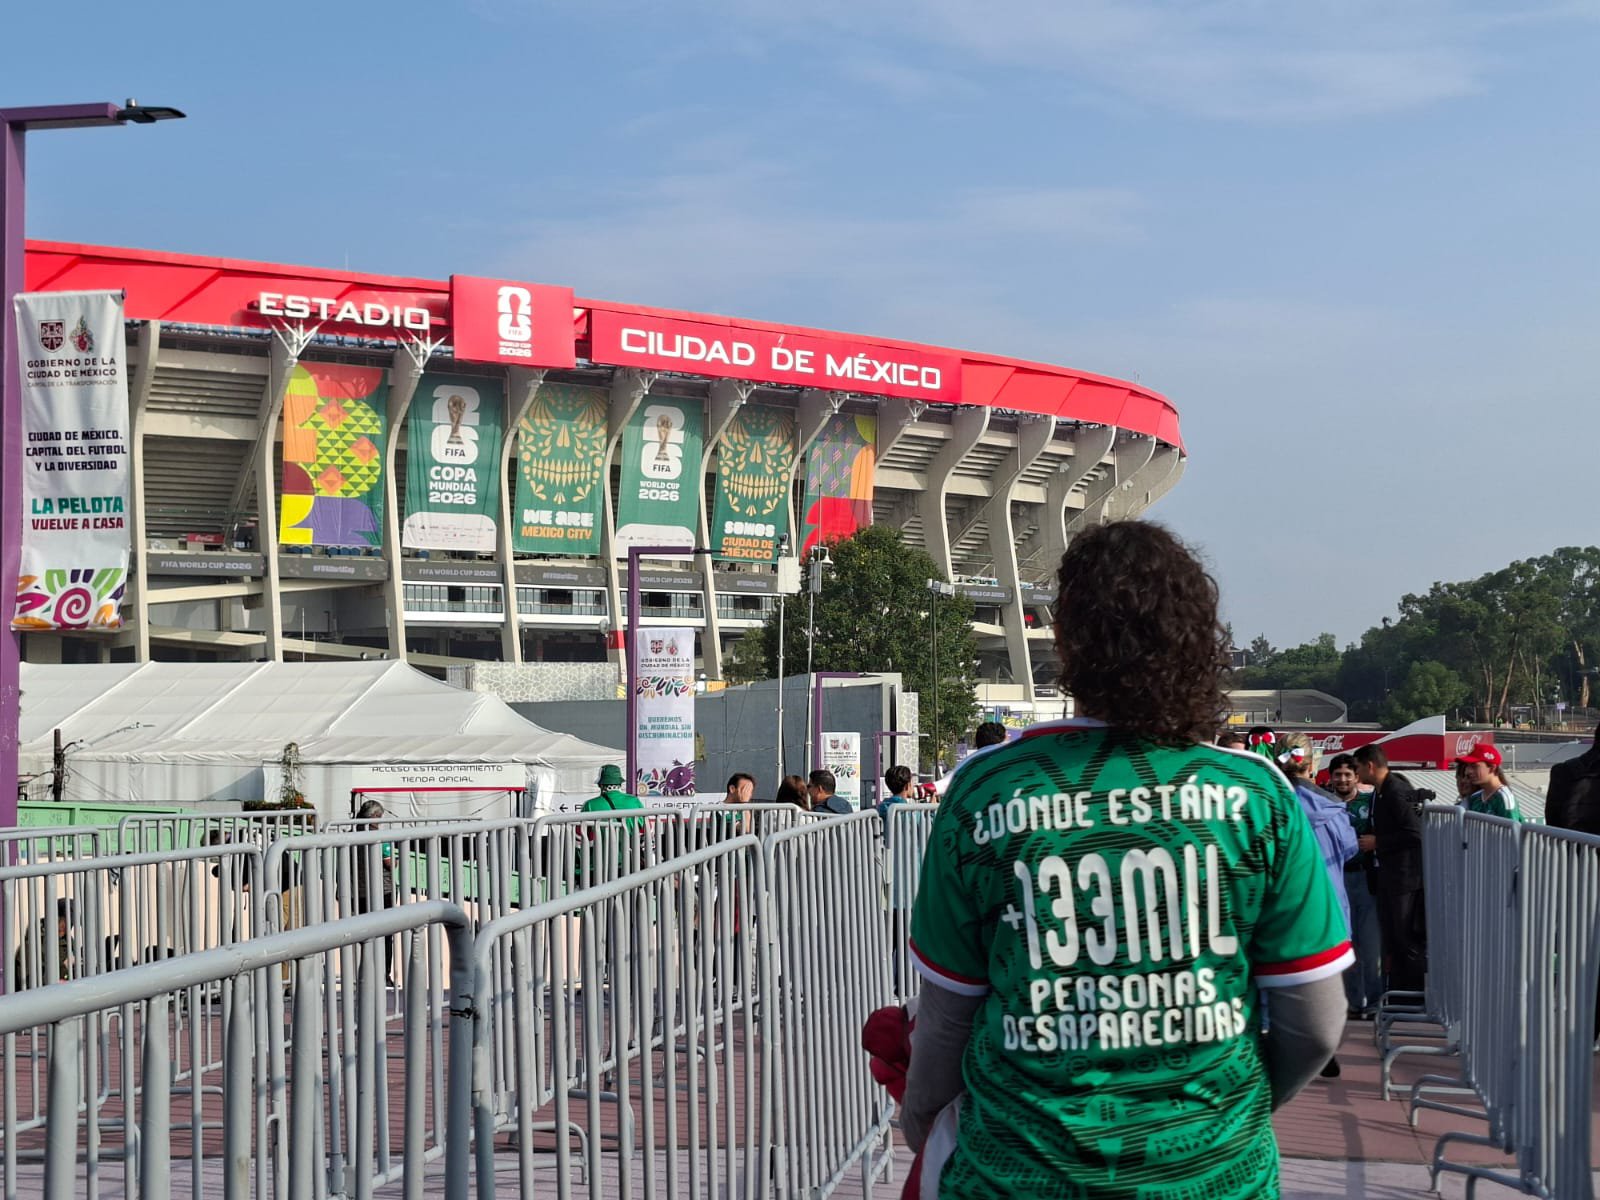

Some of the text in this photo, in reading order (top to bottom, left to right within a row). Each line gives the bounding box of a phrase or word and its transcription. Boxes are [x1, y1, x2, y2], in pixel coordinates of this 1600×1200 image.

[259, 292, 430, 330] ESTADIO
[499, 346, 532, 358] 2026
[27, 357, 116, 368] GOBIERNO DE LA
[621, 328, 941, 390] CIUDAD DE MÉXICO
[27, 370, 61, 379] CIUDAD
[80, 368, 117, 377] MÉXICO
[28, 431, 62, 442] CIUDAD
[65, 431, 78, 440] DE
[26, 446, 63, 456] CAPITAL
[66, 446, 85, 455] DEL
[445, 448, 465, 457] FIFA
[35, 460, 117, 471] Y LA DIVERSIDAD
[653, 464, 671, 472] FIFA
[430, 466, 477, 482] COPA
[429, 481, 476, 492] MUNDIAL
[640, 480, 680, 490] WORLD CUP
[428, 491, 476, 504] 2026
[638, 488, 680, 502] 2026
[32, 496, 124, 514] LA PELOTA
[32, 517, 124, 530] VUELVE A CASA
[523, 509, 594, 527] WE ARE
[522, 526, 592, 540] MEXICO CITY
[724, 520, 775, 538] SONOS
[722, 536, 774, 549] CIUDAD DE
[179, 561, 207, 569] WORLD
[225, 562, 252, 570] 2026
[371, 764, 503, 773] ACCESO ESTACIONAMIENTO
[973, 775, 1248, 845] ¿DÓNDE ESTÁN?
[1030, 967, 1216, 1014] PERSONAS
[1002, 997, 1247, 1052] DESAPARECIDAS
